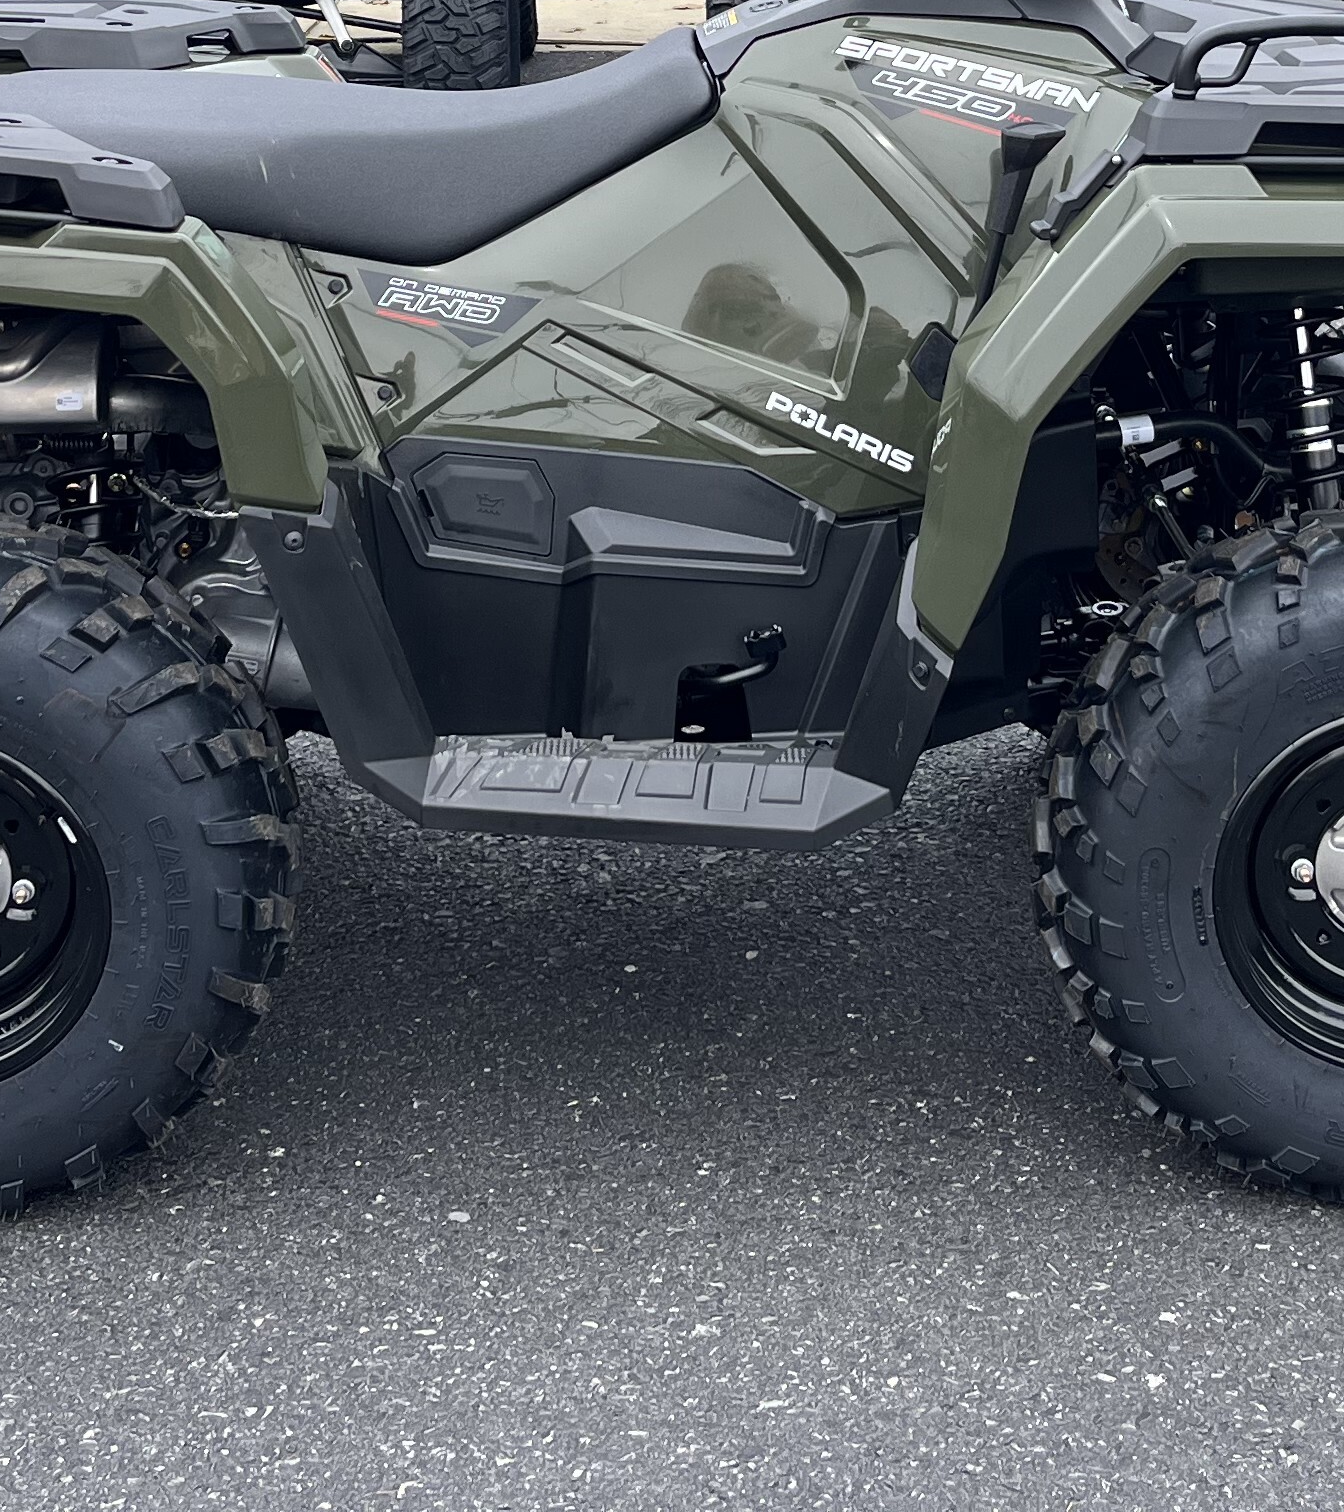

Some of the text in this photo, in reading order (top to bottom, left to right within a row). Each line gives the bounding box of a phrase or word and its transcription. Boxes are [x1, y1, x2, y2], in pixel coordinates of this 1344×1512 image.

[835, 36, 1100, 112] SPORTSMAN
[872, 70, 1016, 121] 450
[378, 286, 500, 324] AWD
[765, 391, 914, 473] POLARIS
[143, 809, 193, 1038] CARLSTAR
